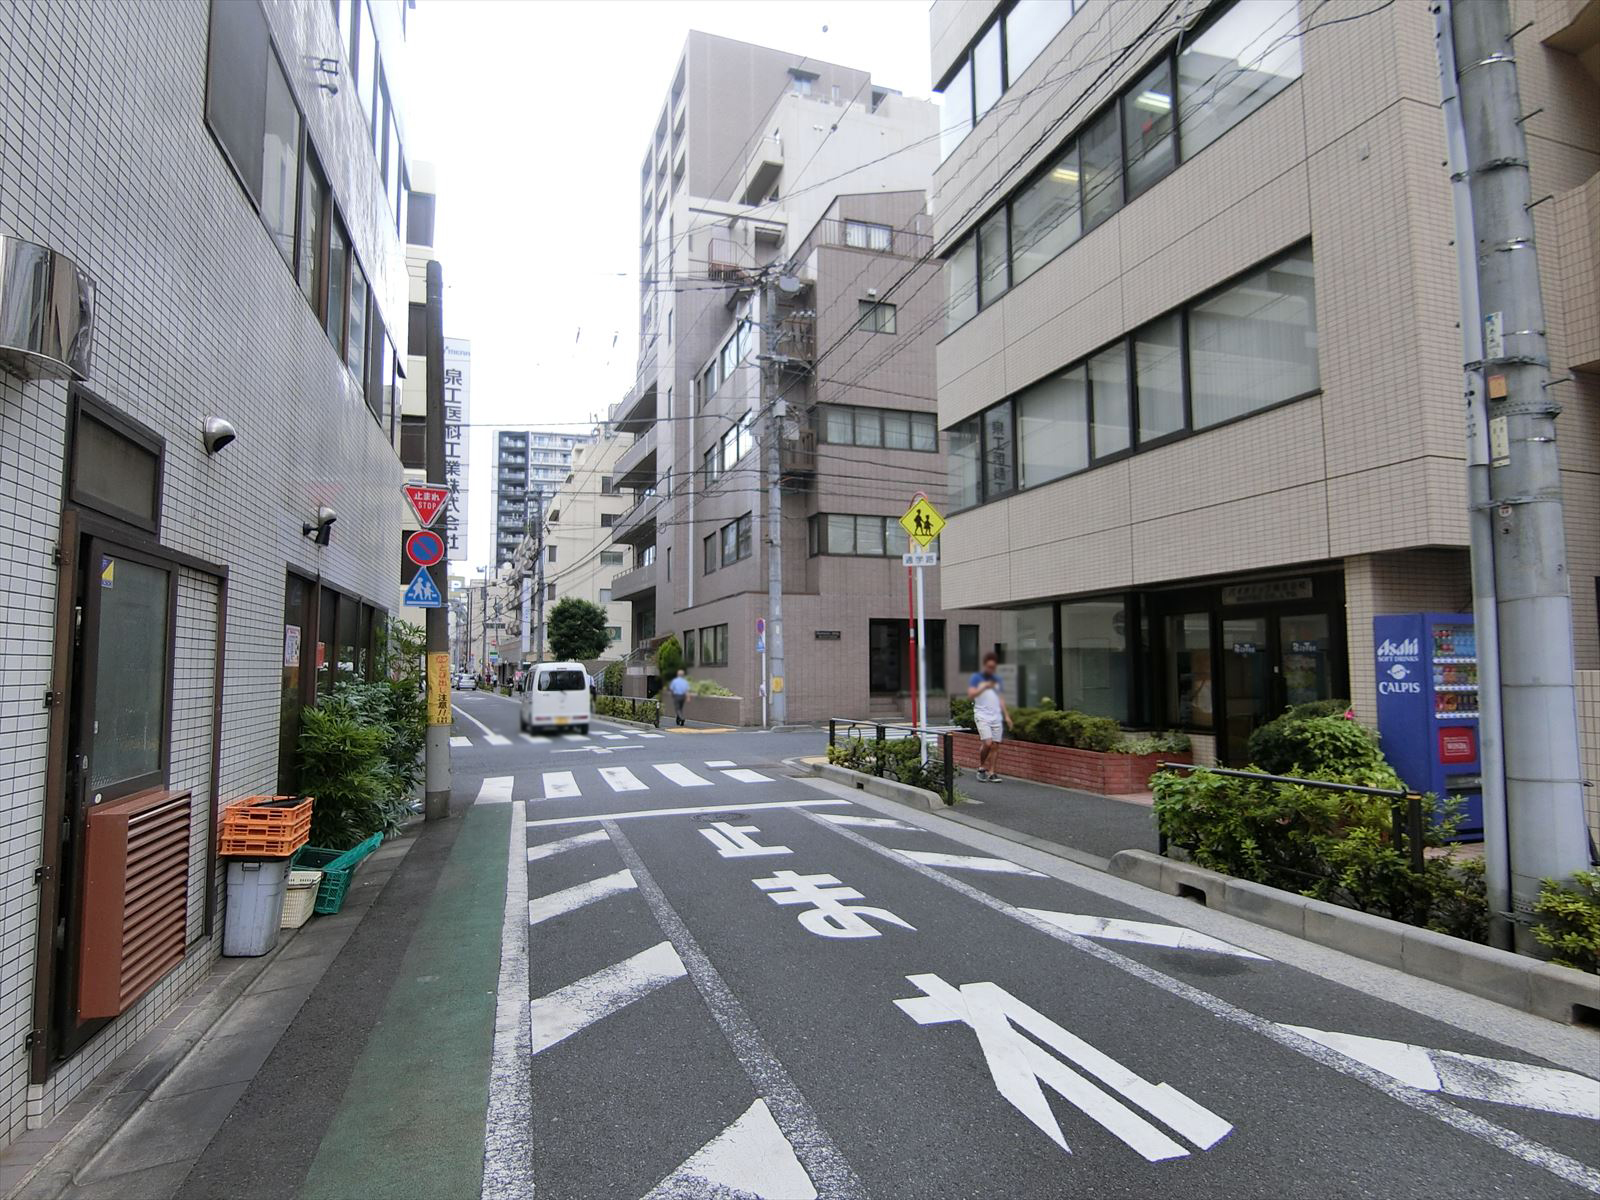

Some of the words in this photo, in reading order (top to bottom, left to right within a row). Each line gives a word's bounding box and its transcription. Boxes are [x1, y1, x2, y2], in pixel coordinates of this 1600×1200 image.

[444, 368, 462, 550] 泉工医科工業株式会社
[414, 491, 440, 501] 止まれ
[418, 502, 437, 510] STOP
[1377, 638, 1418, 656] Asahi
[1379, 681, 1421, 695] CALPIS
[698, 821, 1235, 1162] 止まれ
